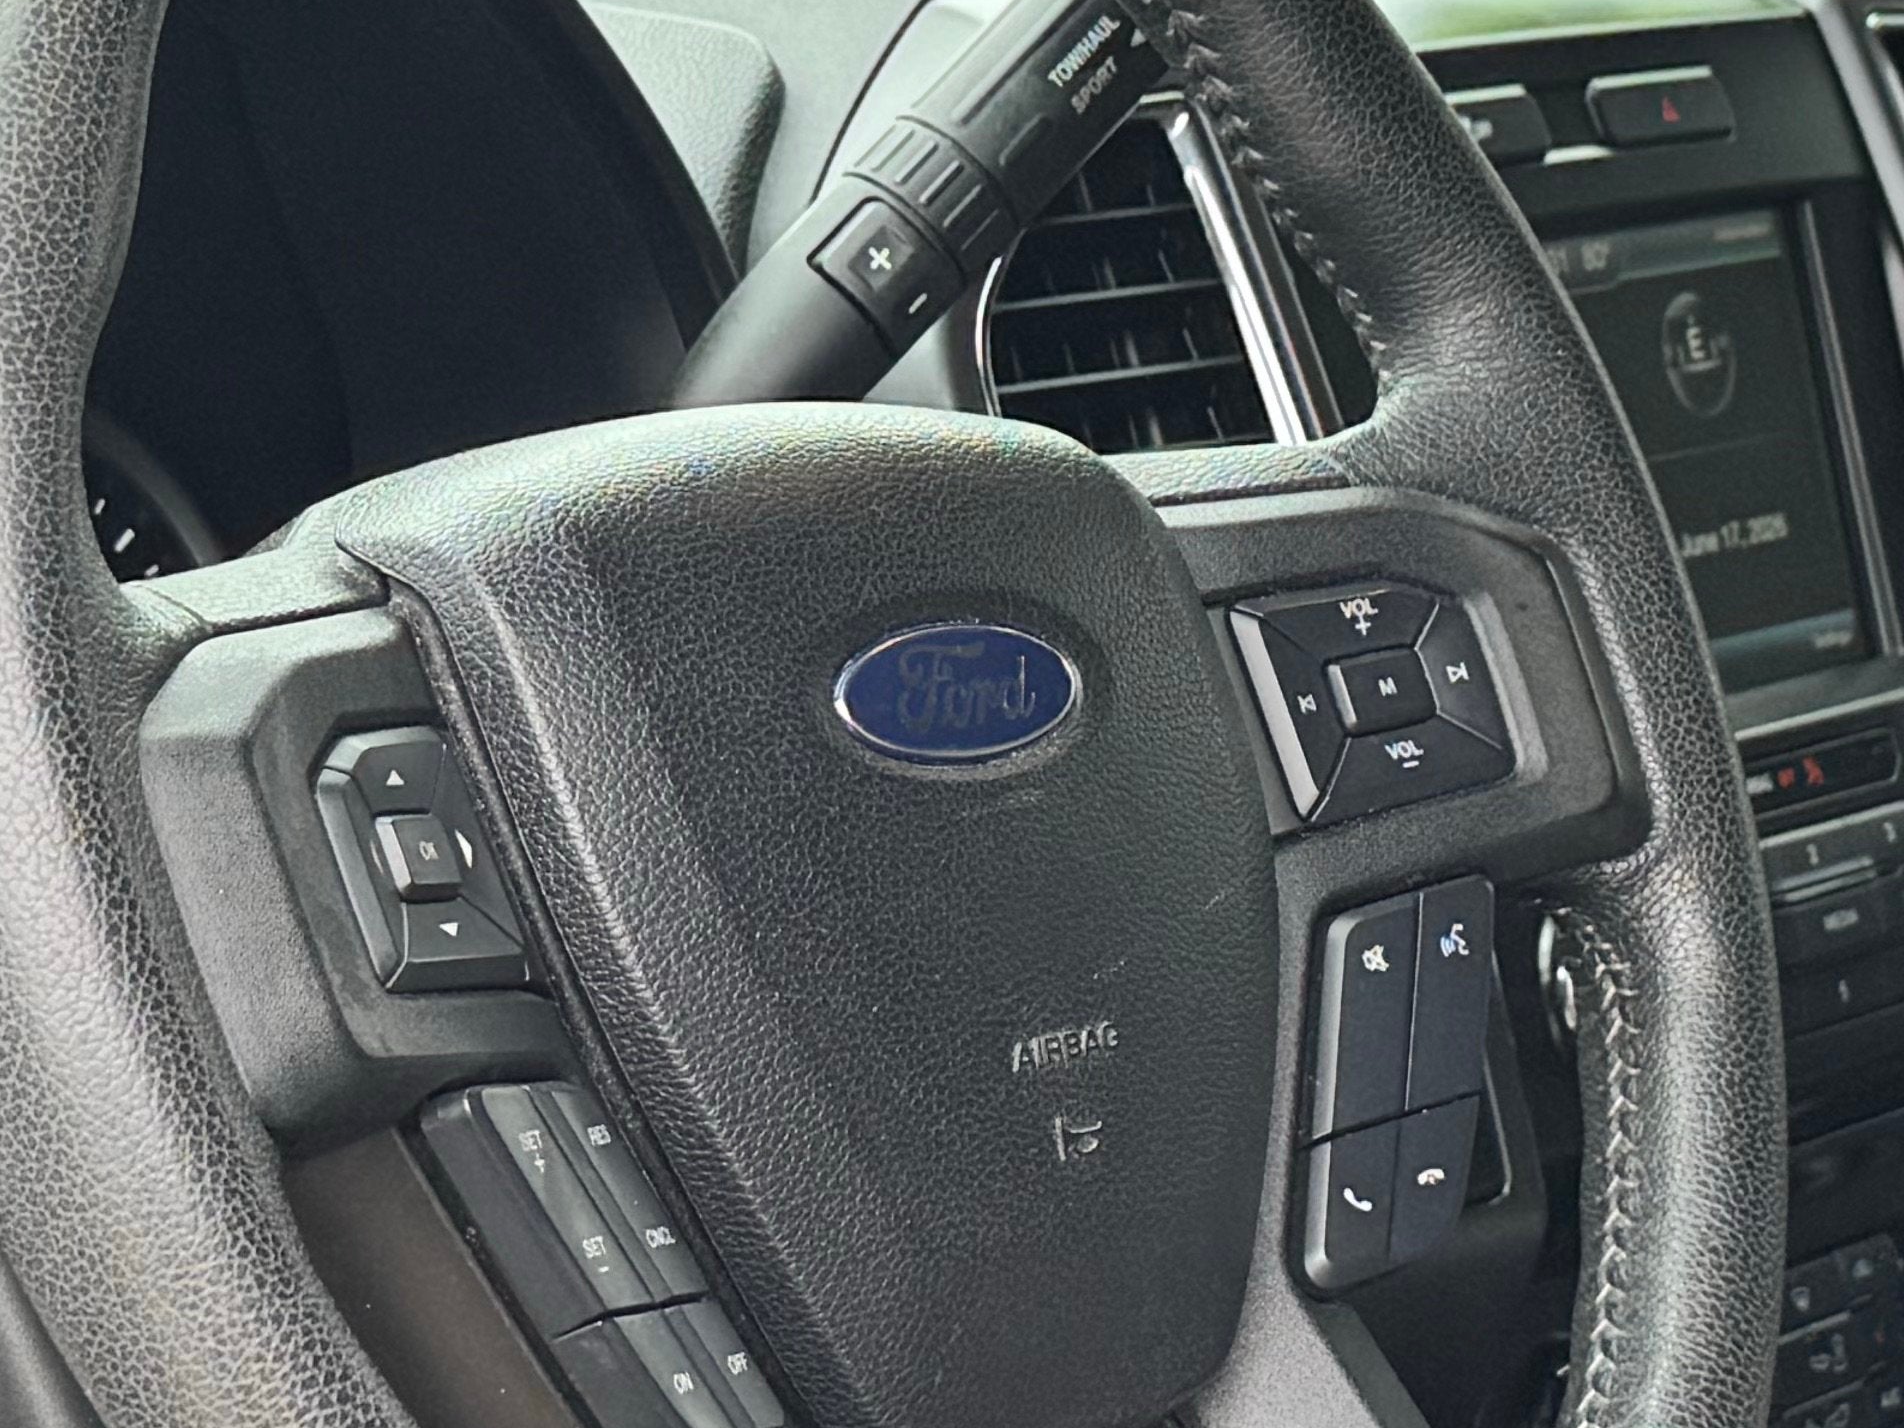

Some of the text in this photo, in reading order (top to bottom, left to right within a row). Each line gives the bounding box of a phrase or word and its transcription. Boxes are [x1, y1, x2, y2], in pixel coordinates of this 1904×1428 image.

[1071, 56, 1118, 115] SPORT
[1339, 598, 1379, 619] VOL
[896, 642, 1037, 737] Ford
[1378, 677, 1398, 697] M
[1384, 740, 1424, 760] VOL
[419, 840, 440, 861] OK
[1012, 1020, 1120, 1072] AIRBAG
[518, 1130, 543, 1151] SET
[582, 1235, 606, 1259] SET
[673, 1372, 694, 1394] ON
